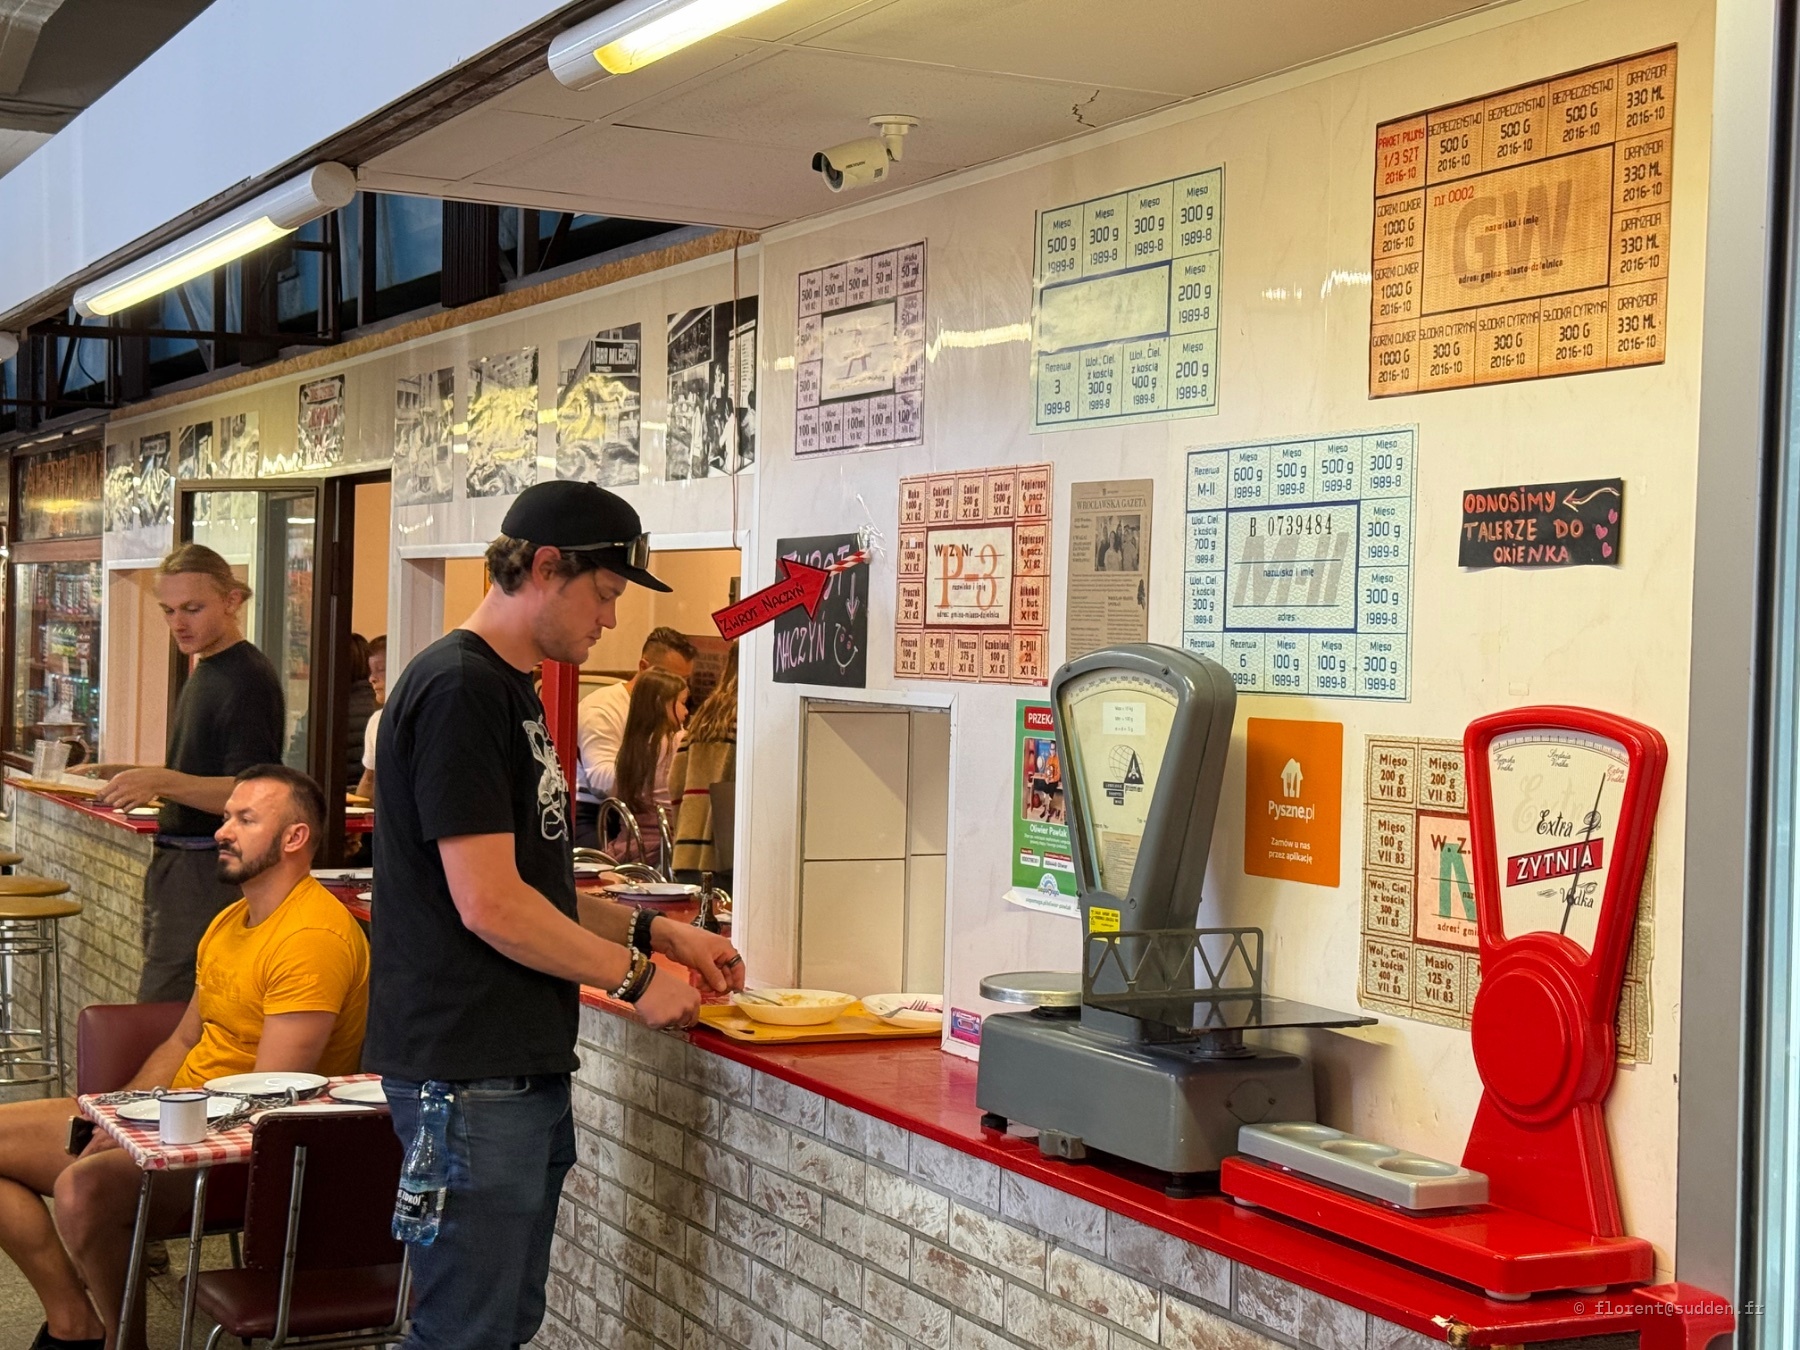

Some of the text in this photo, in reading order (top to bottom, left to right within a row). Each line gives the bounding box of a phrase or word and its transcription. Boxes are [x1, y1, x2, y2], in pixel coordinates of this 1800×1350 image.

[1626, 86, 1665, 110] 330 ML
[1565, 101, 1598, 124] 500 G
[1626, 107, 1665, 129] 2016-10
[1500, 119, 1531, 140] 500 G
[1562, 122, 1600, 143] 2016-10
[1440, 134, 1469, 155] 500 G
[1497, 138, 1533, 159] 2016-10
[1384, 146, 1420, 168] 1/3 SZT
[1437, 153, 1471, 172] 2016-10
[1385, 166, 1417, 185] 2016-10
[1624, 162, 1662, 184] 330 ML
[1186, 184, 1209, 198] Mięso
[1434, 186, 1475, 208] nr 0002
[1623, 181, 1662, 203] 2016-10
[1139, 196, 1160, 209] Mięso
[1095, 207, 1114, 220] Mięso
[1180, 204, 1214, 224] 300 g
[1053, 219, 1072, 231] Mięso
[1134, 215, 1165, 235] 300 g
[1383, 216, 1415, 236] 1000 G
[1089, 225, 1119, 245] 300 g
[1180, 227, 1212, 247] 1989-8
[1453, 179, 1573, 290] GW
[1047, 236, 1077, 255] 500 g
[1134, 238, 1163, 256] 1989-8
[1382, 235, 1414, 254] 2016-10
[1620, 234, 1660, 256] 330 ML
[1048, 257, 1075, 275] 1989-8
[1090, 248, 1118, 266] 1989-8
[1620, 255, 1660, 274] 2016-10
[1184, 264, 1206, 277] Mięso
[1178, 283, 1212, 301] 200 g
[1178, 306, 1210, 324] 1989-8
[1559, 322, 1591, 342] 300 G
[1555, 343, 1593, 361] 2016-10
[1282, 448, 1302, 459] Mięso
[1327, 443, 1349, 455] Mięso
[1376, 439, 1398, 451] Mięso
[1239, 453, 1258, 463] Mięso
[1369, 454, 1403, 471] 300 g
[1233, 467, 1263, 484] 600 g
[1276, 463, 1307, 480] 500 g
[1321, 459, 1354, 476] 500 g
[1276, 481, 1305, 496] 1989-8
[1321, 479, 1352, 493] 1989-8
[1369, 474, 1401, 489] 1989-8
[1233, 485, 1261, 499] 1989-8
[1373, 506, 1395, 517] Mięso
[1249, 513, 1333, 538] B 0739484
[1367, 522, 1401, 540] 300 g
[1463, 518, 1584, 543] TALERZE DO
[962, 543, 973, 557] Nr
[1367, 545, 1399, 559] 1989-8
[720, 581, 806, 633] ZWROT NACZYŃ
[1276, 640, 1296, 651] Mięso
[1273, 654, 1300, 673] 100 g
[1271, 673, 1301, 687] 1989-8
[1380, 753, 1408, 770] Mięso
[1428, 757, 1458, 773] Mięso
[1380, 769, 1405, 786] 200 g
[1430, 773, 1456, 790] 200 g
[1380, 784, 1407, 799] VII 83
[1427, 788, 1457, 804] VII 83
[1268, 800, 1315, 824] Pyszne.pl
[1378, 819, 1405, 836] Mięso
[1536, 809, 1574, 838] Extra
[1270, 836, 1294, 848] Zamów
[1299, 841, 1311, 850] nas
[1380, 835, 1403, 852] 100 g
[1430, 833, 1471, 856] W. Z.
[1268, 851, 1313, 865] przez aplikację
[1378, 850, 1405, 866] VII 83
[1560, 887, 1595, 908] Vdka
[1425, 955, 1454, 972] Masło
[1426, 972, 1452, 990] 125 g
[1425, 986, 1454, 1004] VII 83
